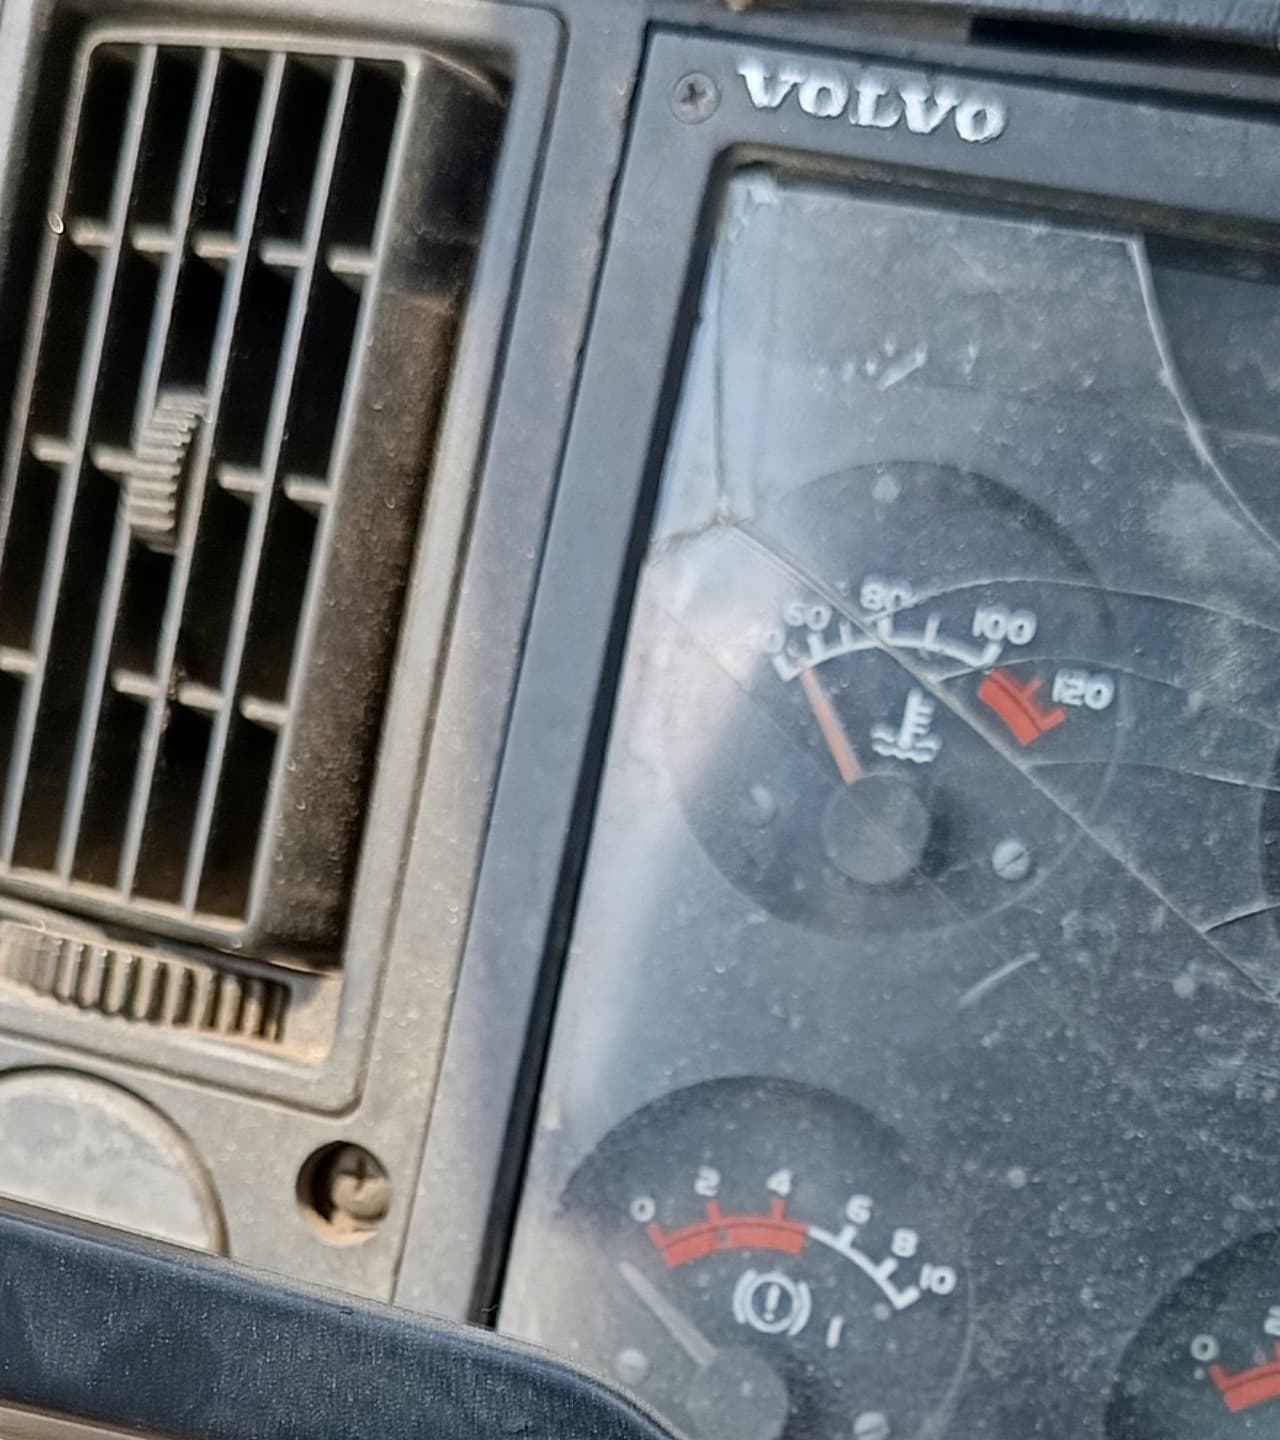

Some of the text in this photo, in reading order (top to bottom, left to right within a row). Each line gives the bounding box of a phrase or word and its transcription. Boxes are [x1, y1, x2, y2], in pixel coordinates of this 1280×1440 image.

[734, 56, 1008, 143] VOLVO
[972, 606, 1037, 645] 100
[1051, 668, 1115, 710] 120
[694, 1166, 721, 1197] 2
[766, 1168, 793, 1197] 4
[630, 1197, 656, 1223] 0
[846, 1194, 873, 1223] 6
[891, 1228, 918, 1258] 8
[919, 1263, 957, 1295] 10
[1190, 1334, 1219, 1361] 0
